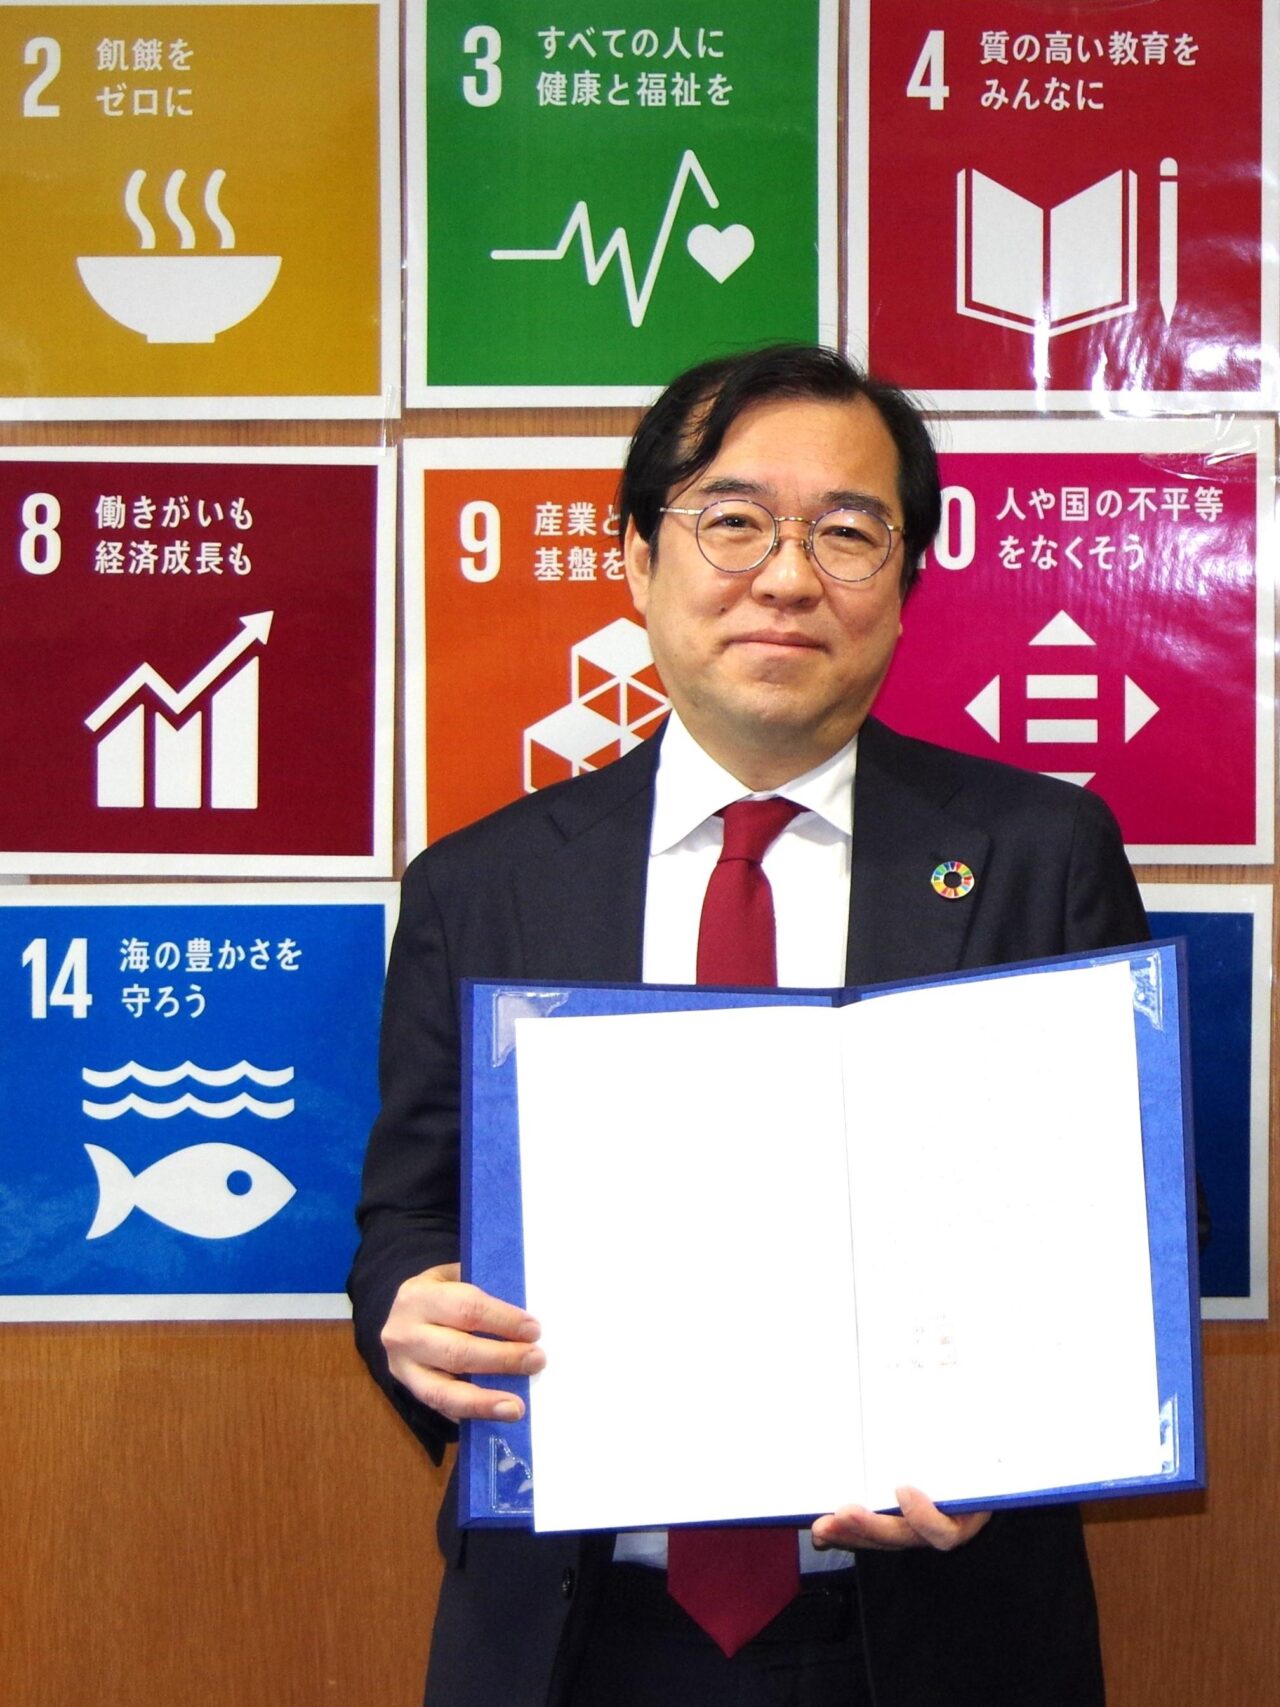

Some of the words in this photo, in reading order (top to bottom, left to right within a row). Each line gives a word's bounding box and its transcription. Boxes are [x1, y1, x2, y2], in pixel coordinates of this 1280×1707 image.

[97, 38, 194, 71] 飢餓を
[537, 25, 725, 60] すべての人に
[979, 30, 1200, 67] 質の高い教育を
[23, 37, 61, 117] 2
[463, 25, 502, 107] 3
[906, 30, 950, 111] 4
[97, 82, 193, 116] ゼロに
[537, 70, 733, 107] 健康と福祉を
[980, 77, 1105, 111] みんなに
[95, 495, 254, 530] 働きがいも
[996, 486, 1224, 522] 人や国の不平等
[19, 492, 61, 575] 8
[460, 500, 501, 583] 9
[917, 485, 976, 570] 0
[95, 540, 253, 575] 経済成長も
[533, 546, 625, 581] 基盤を
[998, 534, 1144, 571] をなくそう
[120, 938, 303, 973] 海の豊かさを
[22, 937, 93, 1019] 14
[121, 983, 208, 1018] 守ろう
